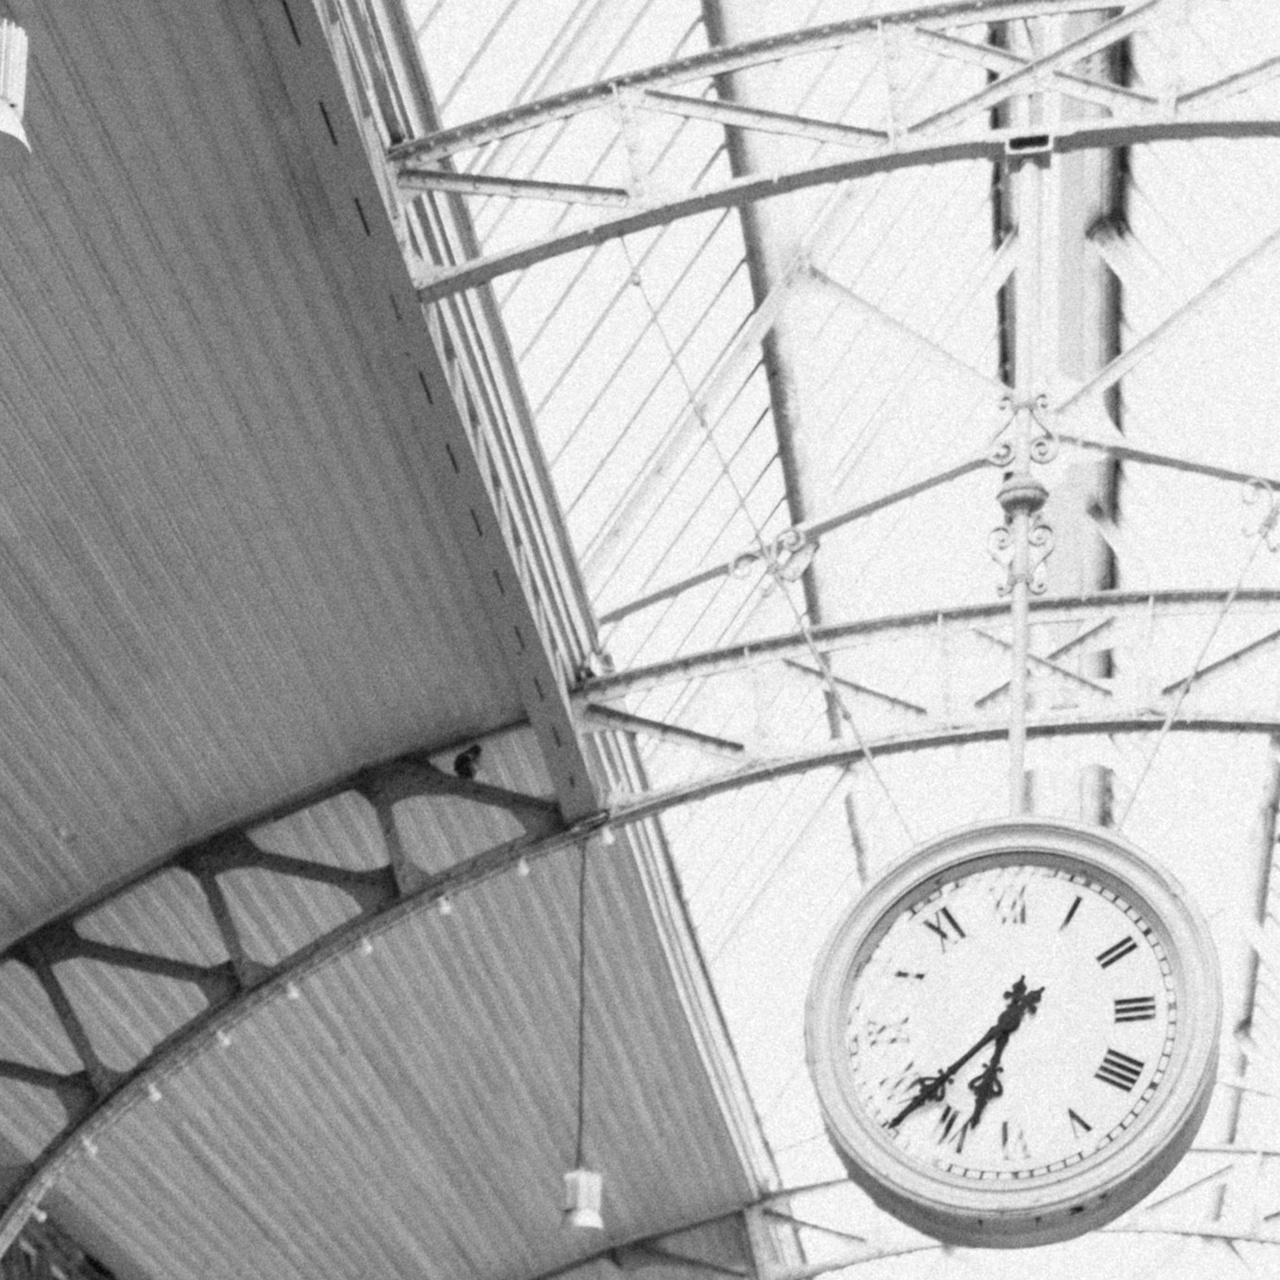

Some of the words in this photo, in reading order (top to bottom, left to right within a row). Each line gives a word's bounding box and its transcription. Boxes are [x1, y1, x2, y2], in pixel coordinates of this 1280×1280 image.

[924, 906, 967, 953] XI
[1060, 896, 1082, 930] I
[1096, 935, 1138, 970] II
[1114, 996, 1156, 1023] III
[1094, 1048, 1145, 1092] IIII
[1068, 1108, 1092, 1138] V
